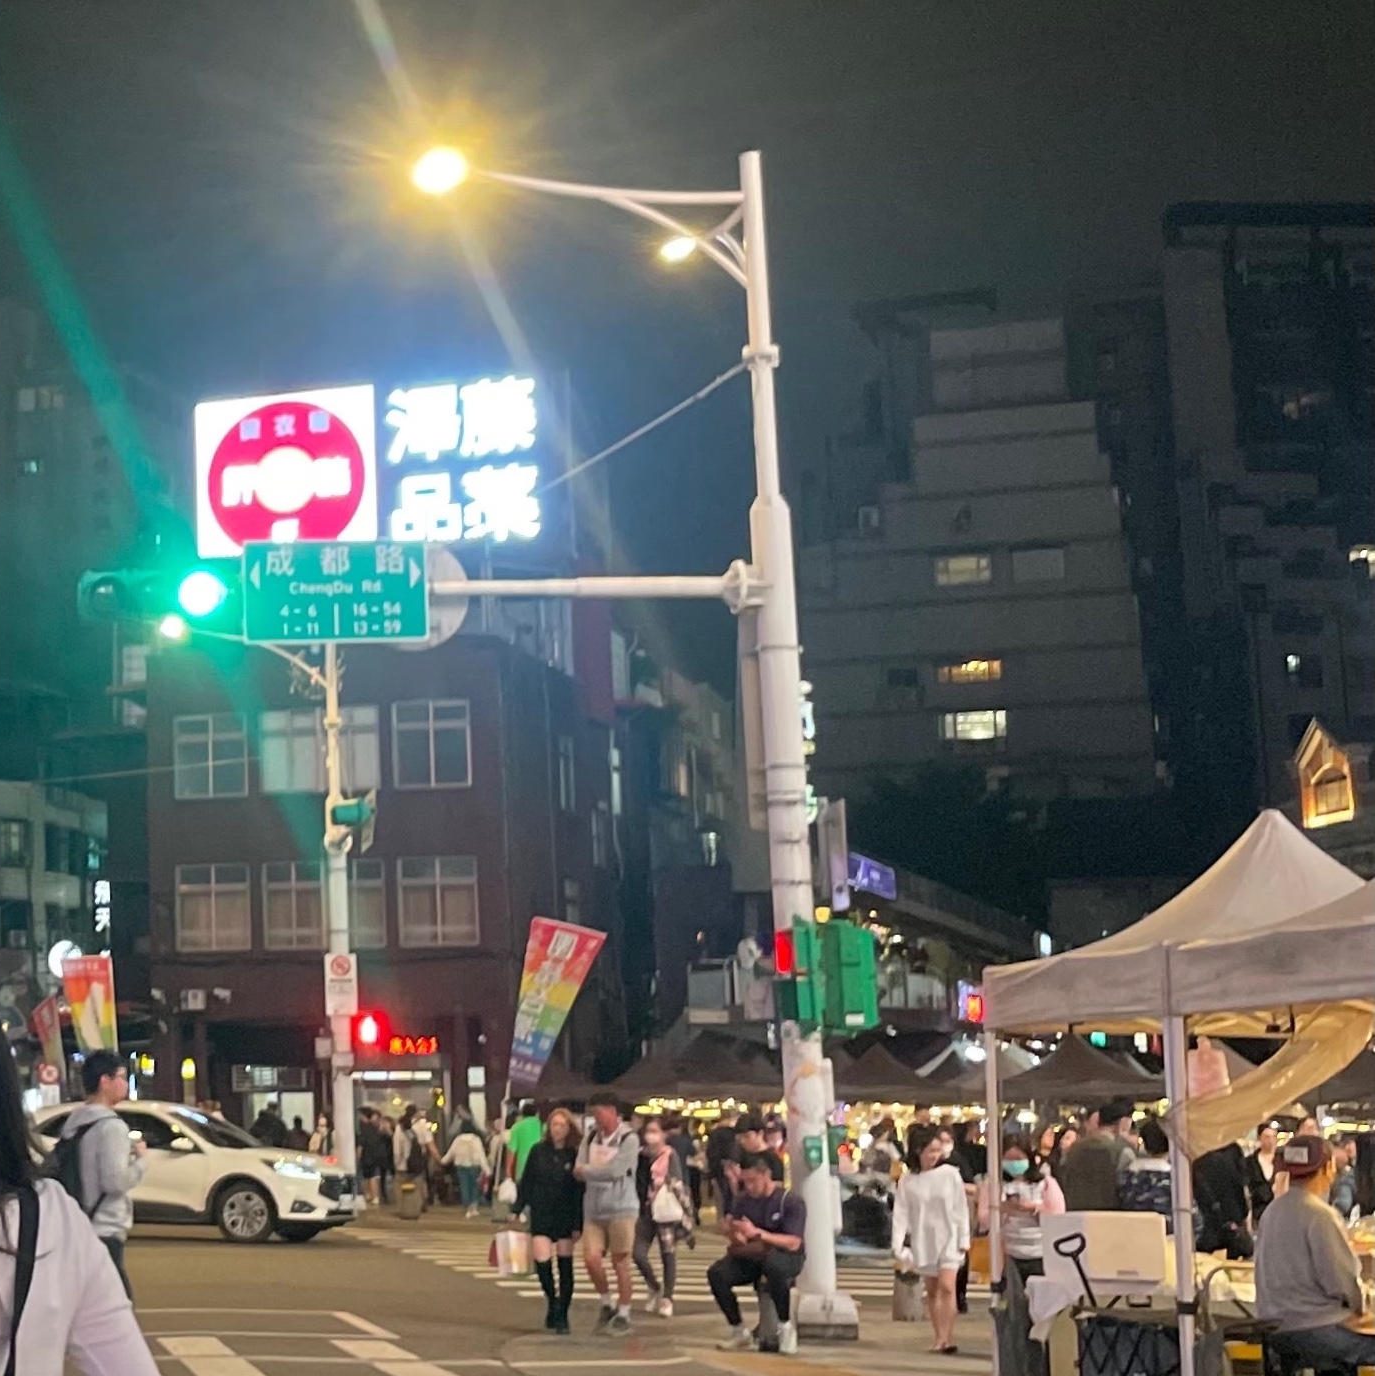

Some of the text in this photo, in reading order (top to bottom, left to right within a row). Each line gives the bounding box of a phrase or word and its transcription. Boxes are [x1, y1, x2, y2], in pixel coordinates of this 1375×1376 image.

[266, 544, 405, 577] 成都路
[289, 579, 353, 597] ChengDu
